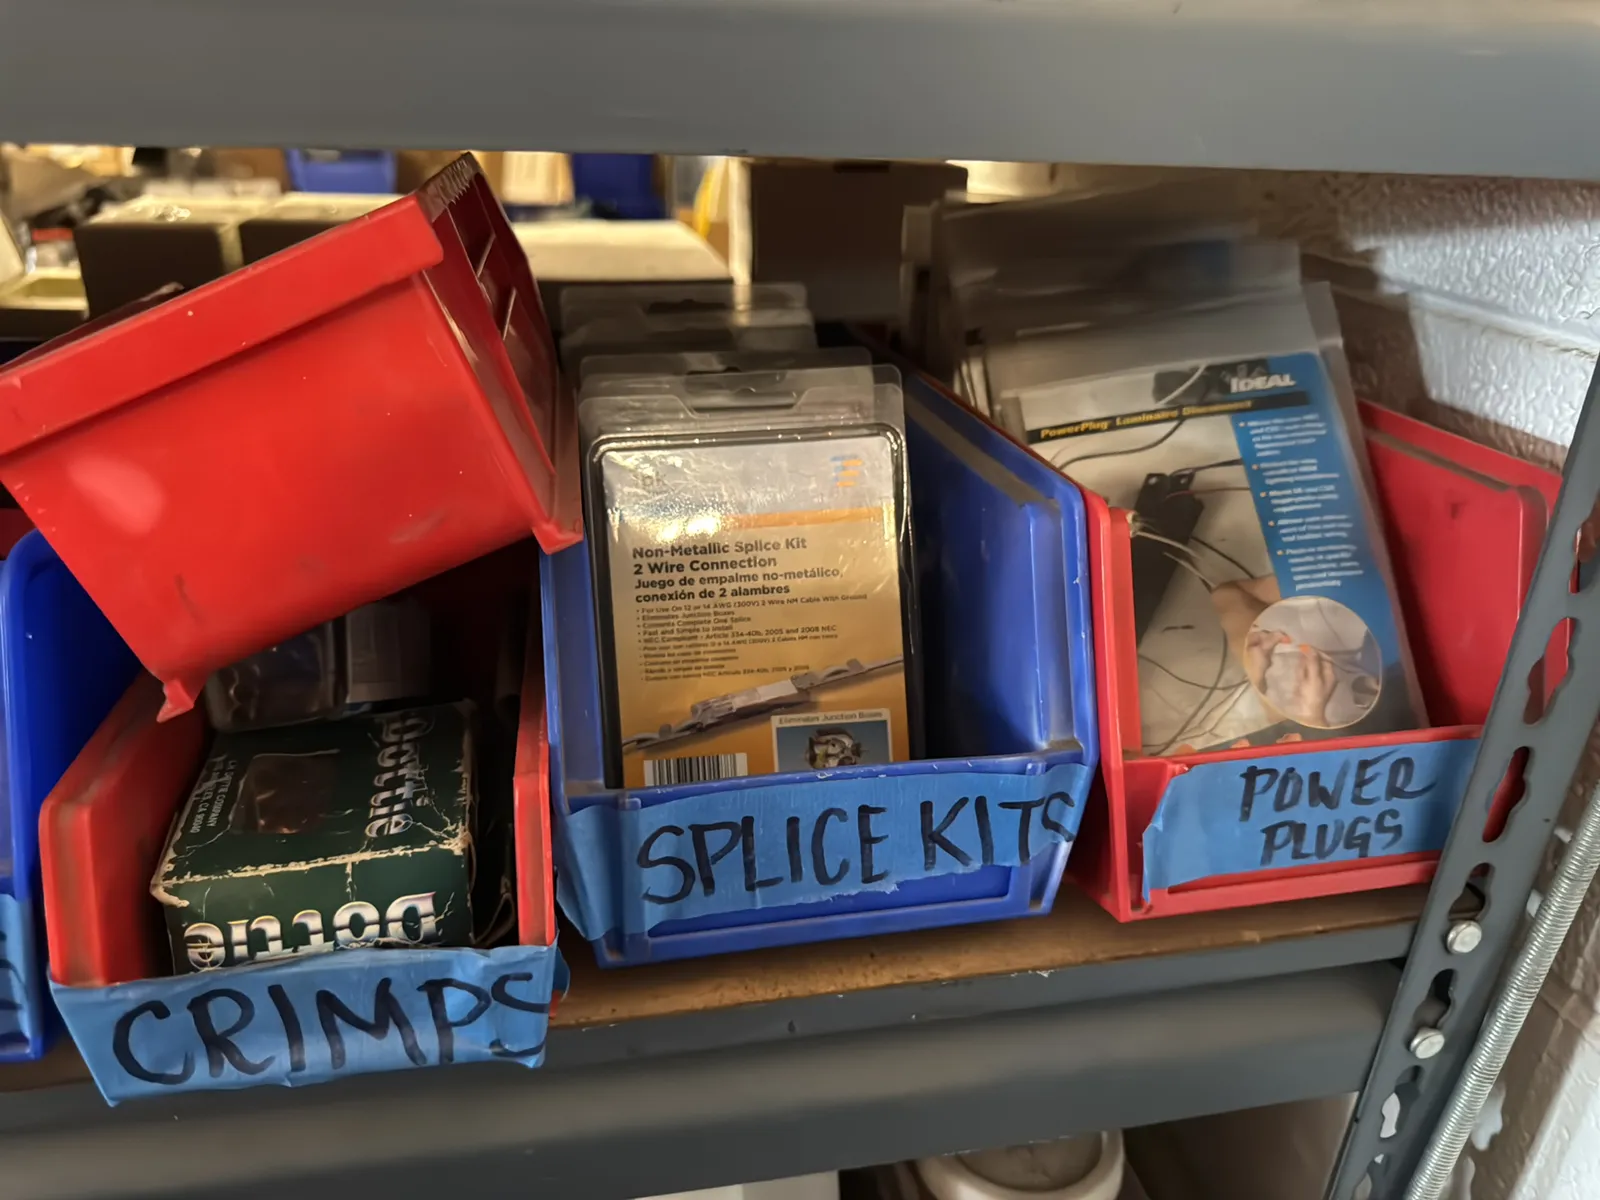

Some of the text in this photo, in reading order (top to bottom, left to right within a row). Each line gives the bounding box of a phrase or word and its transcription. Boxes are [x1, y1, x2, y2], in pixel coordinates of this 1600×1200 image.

[1231, 374, 1296, 393] IDEAL
[1041, 421, 1109, 439] PowerPlug
[633, 537, 807, 559] Non-Metallic Splice Kit
[633, 556, 777, 575] 2 Wire Connection
[635, 567, 843, 591] Juego de empalme no-metálico,
[635, 583, 790, 604] conexión de 2 alambres
[800, 596, 820, 604] Cable
[706, 631, 729, 639] Article
[822, 624, 837, 632] NEC
[1239, 749, 1438, 822] POWER
[637, 791, 1075, 904] SPLICE KITS
[1259, 808, 1403, 866] PLUGS
[112, 973, 549, 1084] CRIMPS
